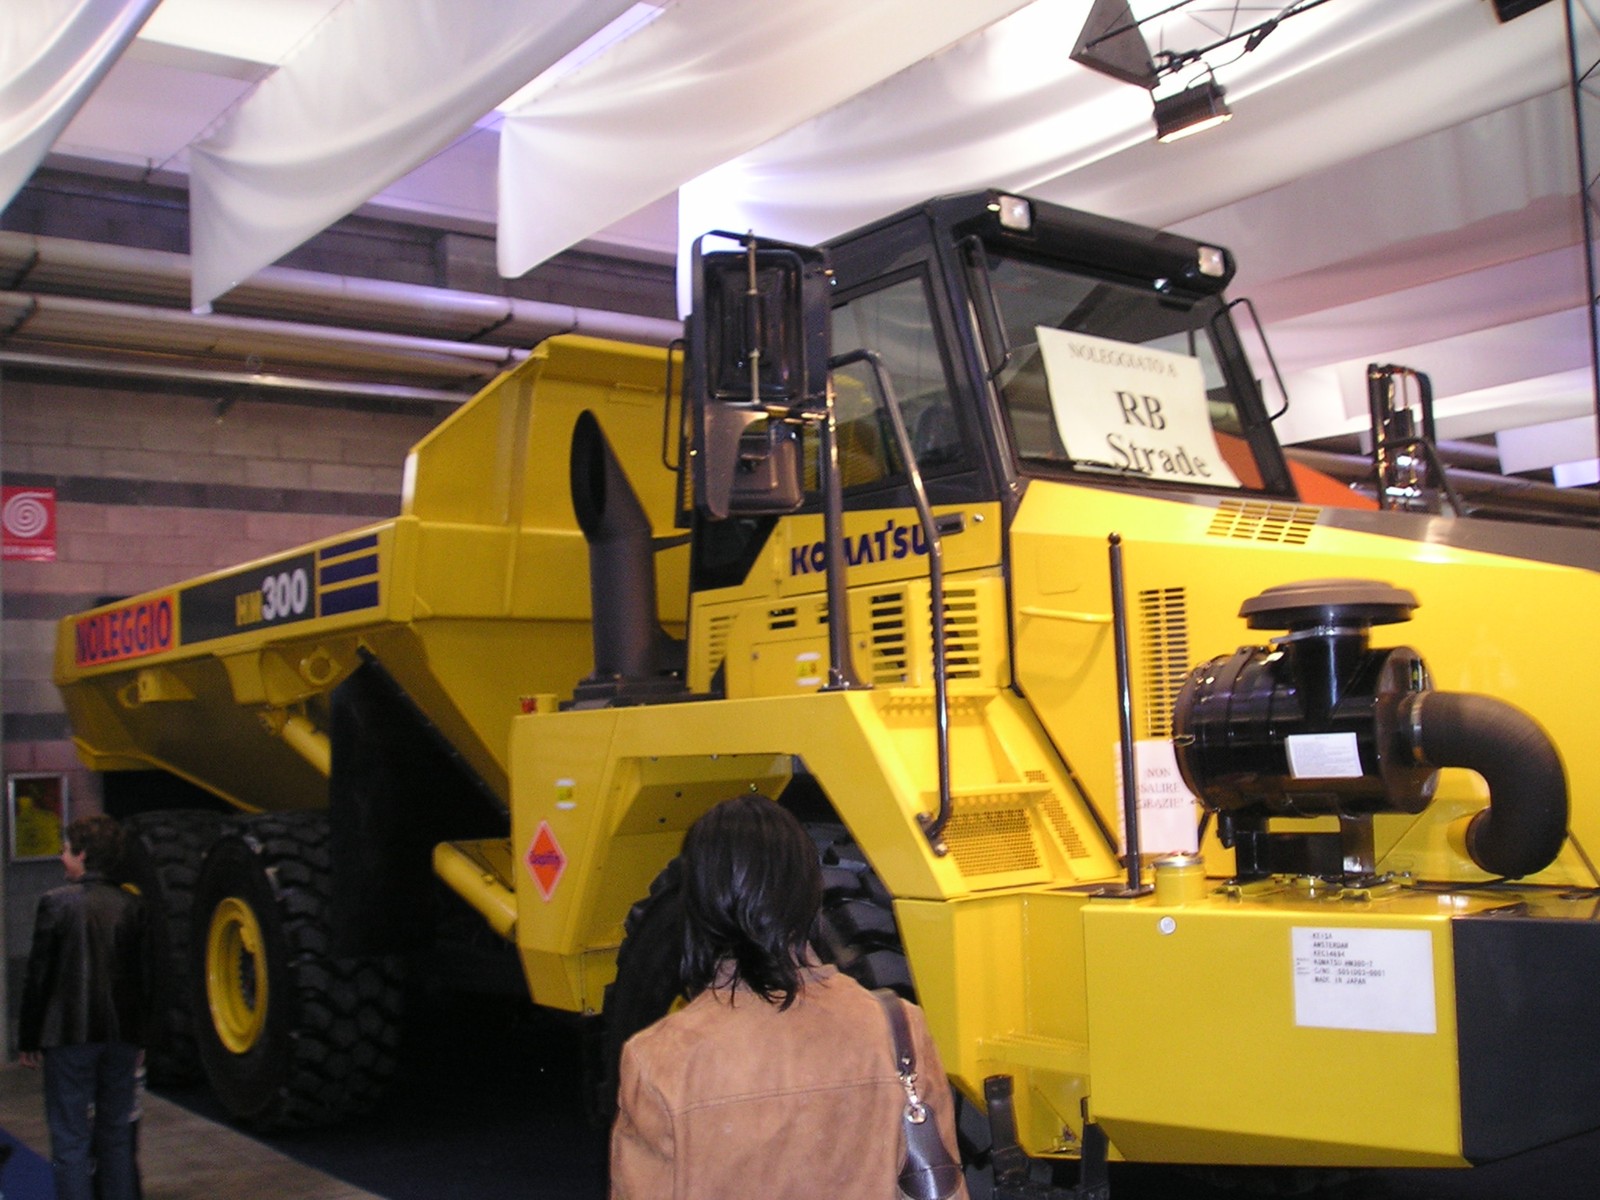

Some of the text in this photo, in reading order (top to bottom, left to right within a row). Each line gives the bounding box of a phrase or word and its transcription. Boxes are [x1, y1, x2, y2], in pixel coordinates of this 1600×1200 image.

[1114, 390, 1166, 430] RB
[1106, 432, 1211, 478] Strade
[75, 600, 173, 663] NOLEGGIO
[1140, 783, 1181, 793] SALIRE
[1146, 767, 1171, 778] NON
